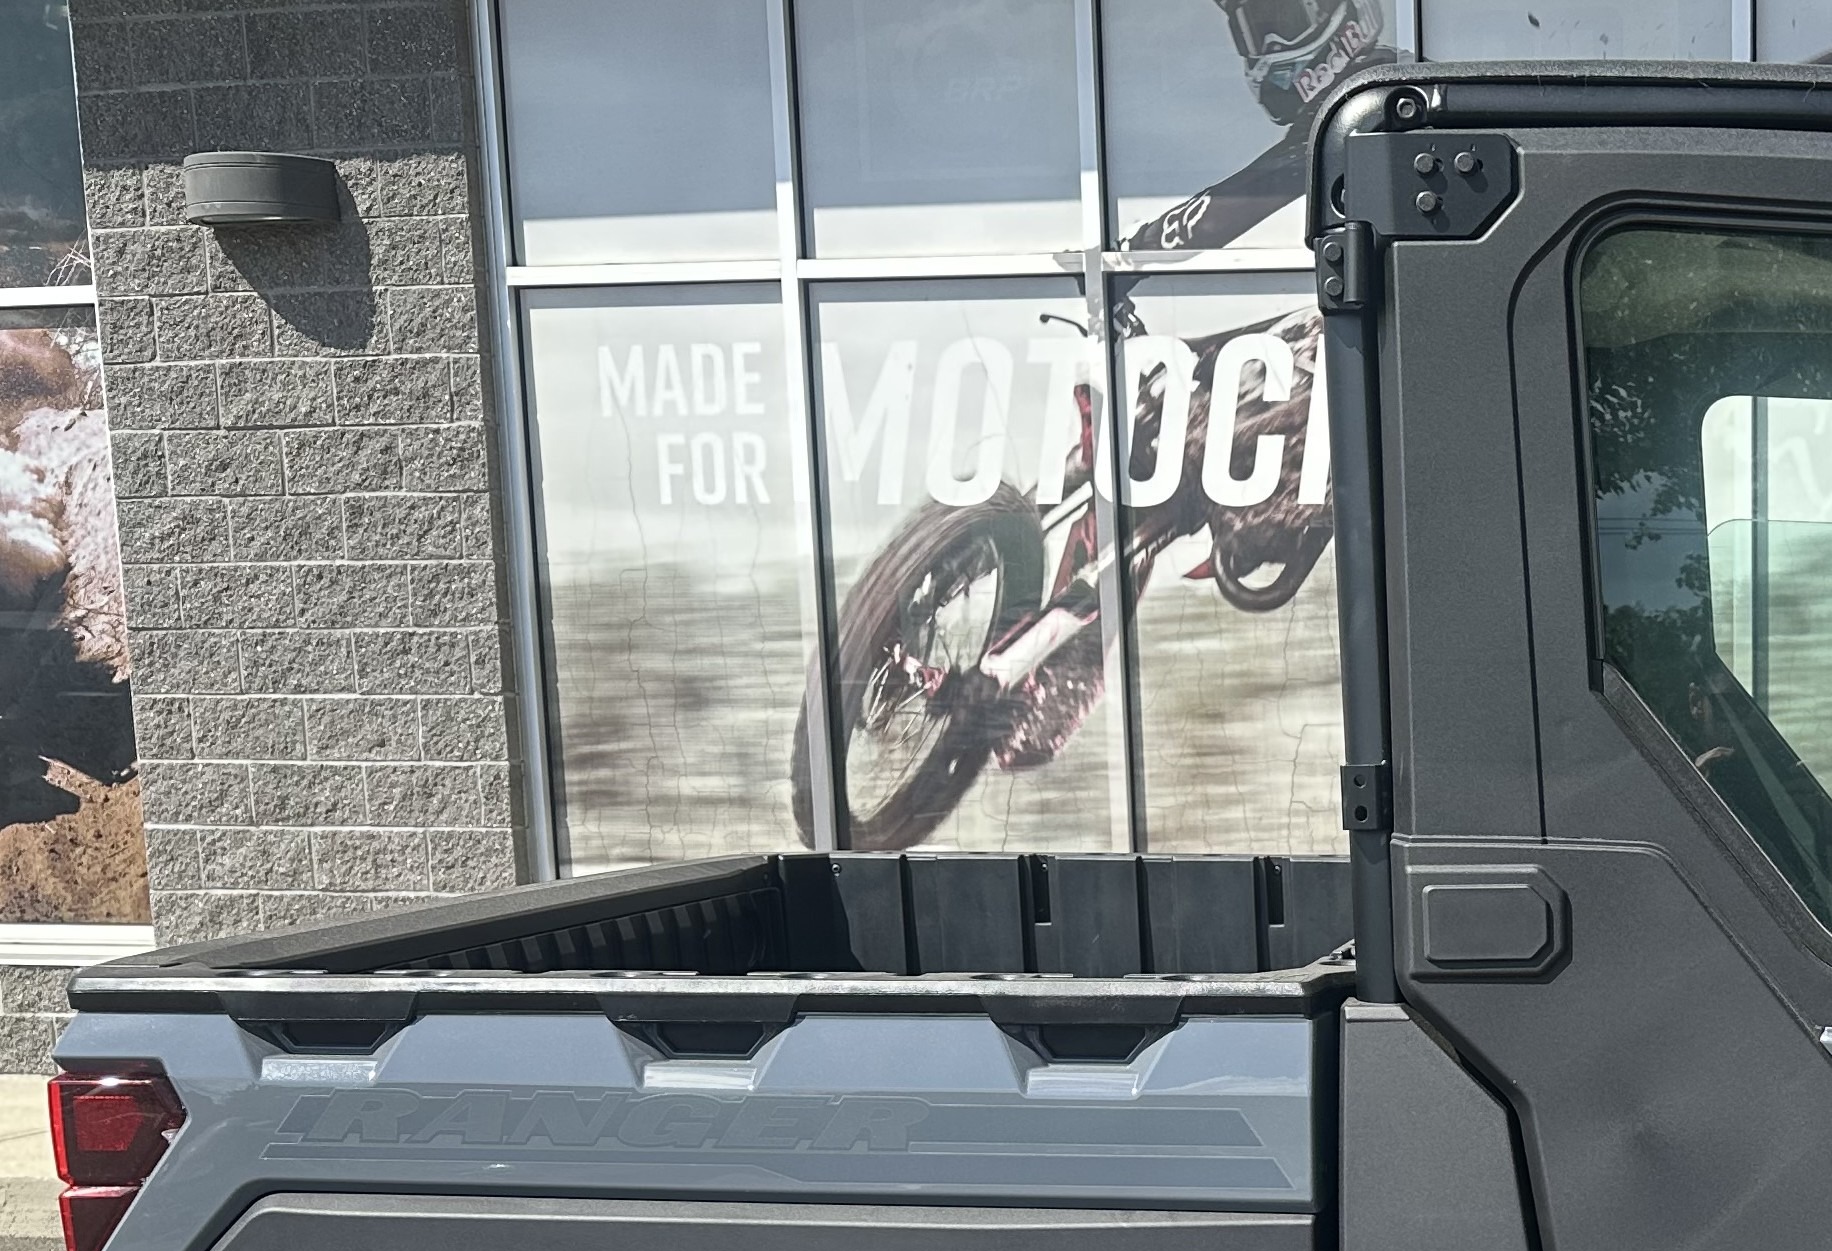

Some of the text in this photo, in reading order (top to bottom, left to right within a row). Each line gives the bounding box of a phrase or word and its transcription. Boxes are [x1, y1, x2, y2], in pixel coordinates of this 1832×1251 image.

[1292, 38, 1352, 103] Red
[598, 343, 765, 417] MADE
[800, 333, 1335, 508] MOTOC
[658, 432, 770, 505] FOR
[300, 1087, 934, 1150] RANGER
